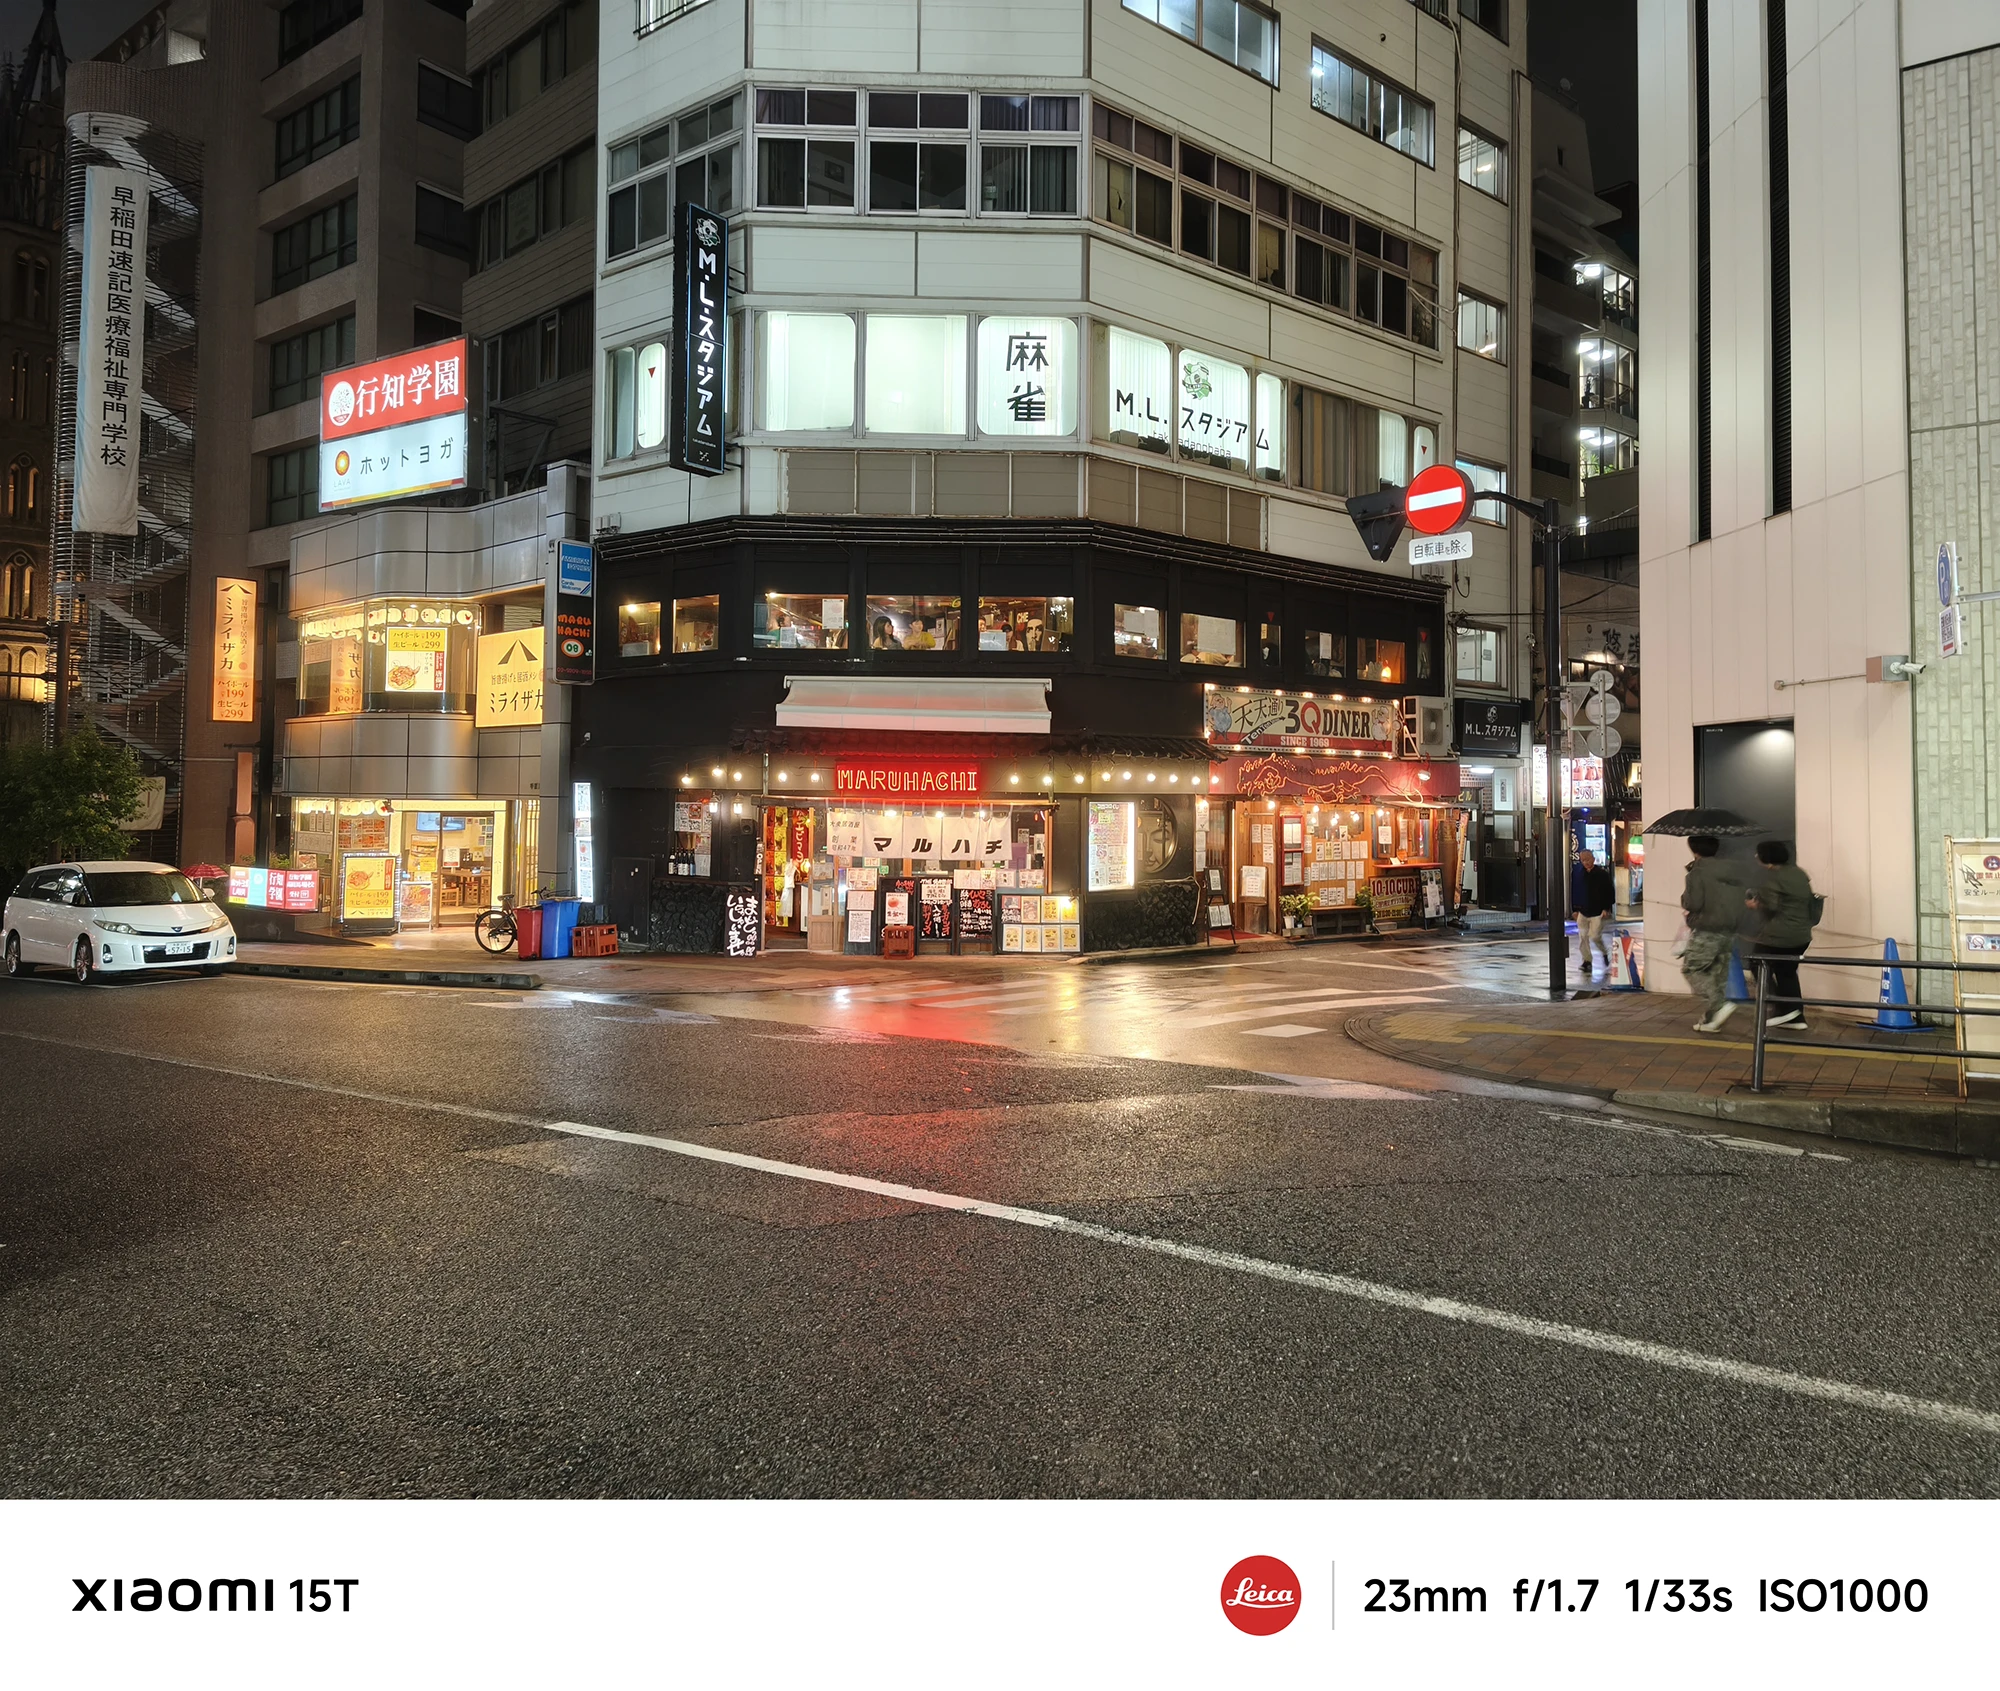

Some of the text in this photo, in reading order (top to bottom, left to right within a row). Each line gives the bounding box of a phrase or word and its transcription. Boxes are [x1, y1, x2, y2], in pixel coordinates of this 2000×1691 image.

[100, 186, 137, 467] 早稲田速記医療福祉専門学校
[356, 356, 460, 418] 行知学園
[1006, 331, 1049, 422] 麻雀
[360, 436, 454, 475] ホットヨガ
[1414, 539, 1467, 558] 自転車を除く
[1016, 611, 1029, 624] CHE
[220, 597, 236, 671] ミライザカ
[393, 631, 420, 639] ハイボール
[218, 680, 250, 688] ハイボール
[217, 700, 249, 708] 生ビール
[1232, 697, 1283, 738] 天天通り
[1323, 709, 1371, 738] DINER
[1280, 736, 1330, 747] SINCE 1969
[755, 853, 764, 875] OPEN
